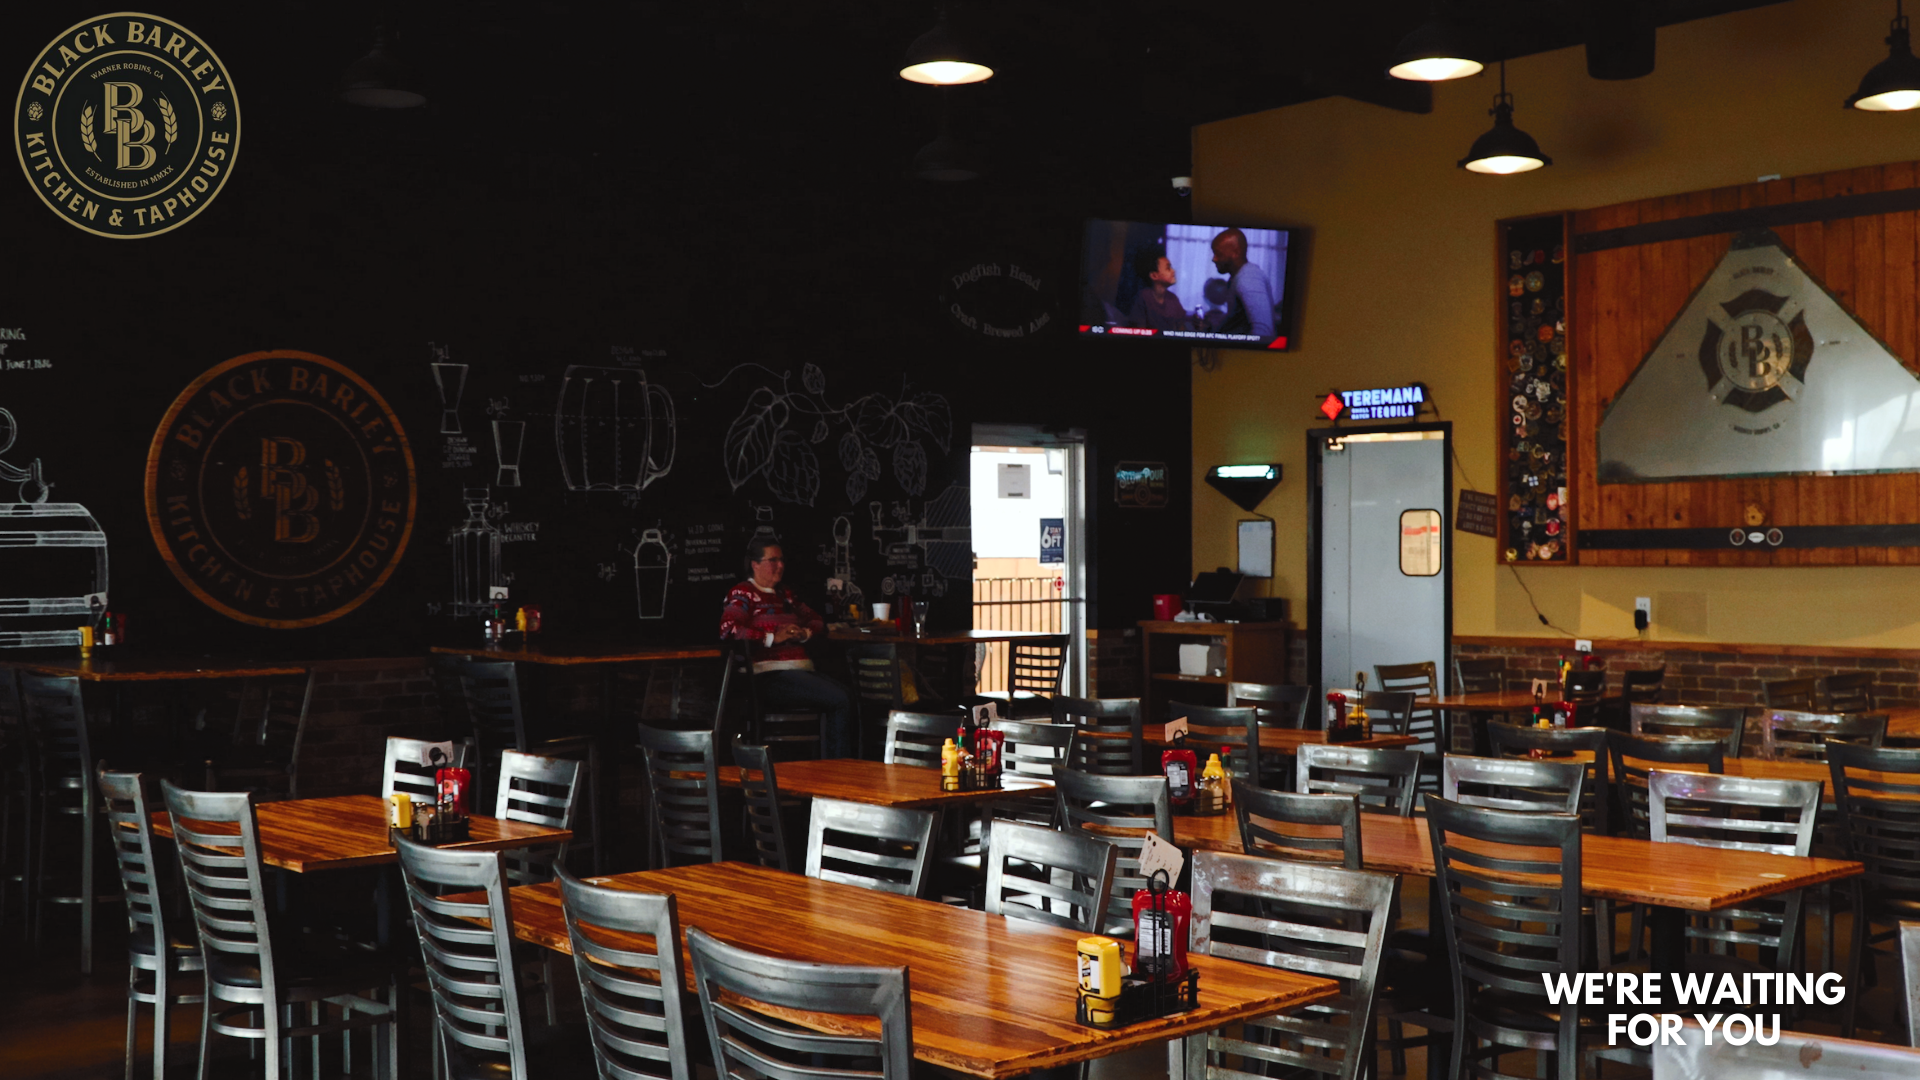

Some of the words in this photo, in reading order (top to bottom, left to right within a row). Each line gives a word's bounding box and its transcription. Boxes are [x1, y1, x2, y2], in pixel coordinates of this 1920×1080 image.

[952, 262, 1001, 290] Dogfish
[1009, 263, 1041, 291] Head
[983, 323, 1024, 338] Brewed
[1341, 386, 1423, 407] TEREMANA
[175, 367, 272, 449] BLACK
[289, 366, 396, 454] BARLEY
[1370, 404, 1415, 419] TEQUILA
[504, 522, 540, 533] WHISKEY
[1041, 526, 1052, 549] 6
[1051, 536, 1062, 548] FT
[167, 494, 254, 600] KITCHEN
[295, 500, 400, 607] TAPHOUSE
